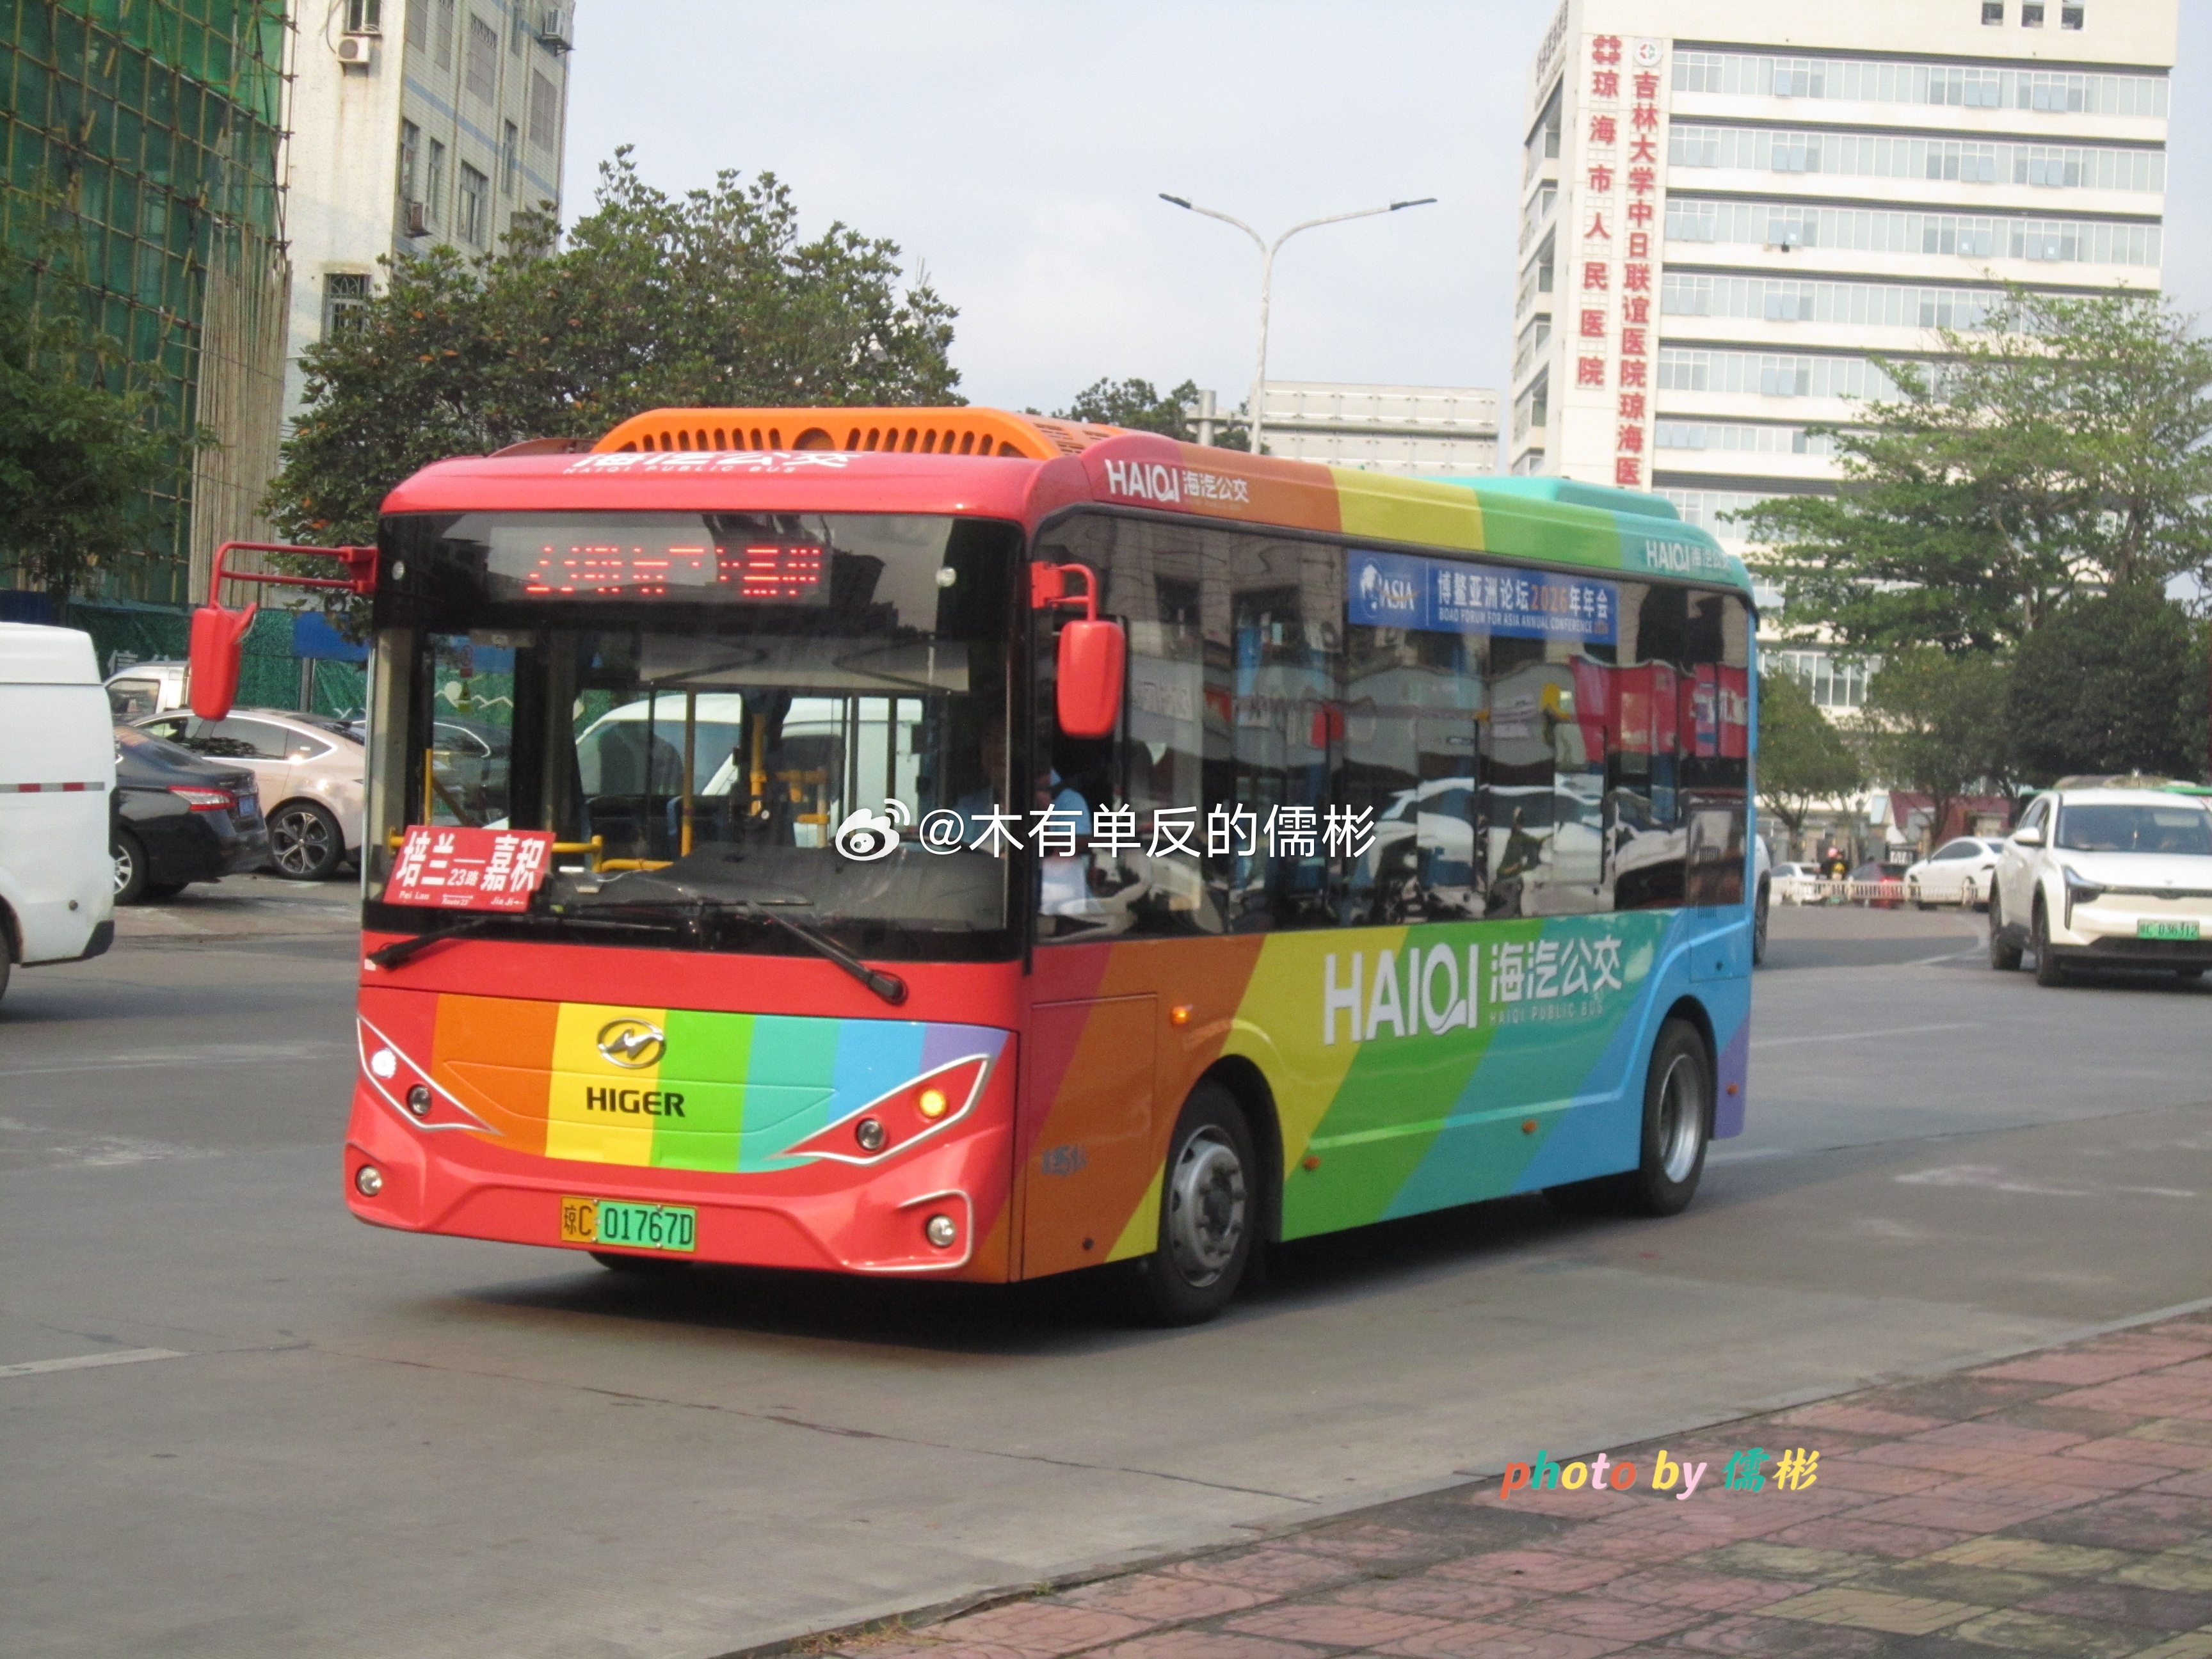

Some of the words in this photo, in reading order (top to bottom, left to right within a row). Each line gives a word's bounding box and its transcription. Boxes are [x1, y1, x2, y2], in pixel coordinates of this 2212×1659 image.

[1578, 69, 1619, 385] 琼海市人民医院
[1105, 458, 1180, 502] HAIQI
[1182, 470, 1249, 503] 海汽公交
[1323, 943, 1479, 1046] HAIQI
[1489, 934, 1623, 1003] 海汽公交
[586, 1086, 685, 1118] HIGER
